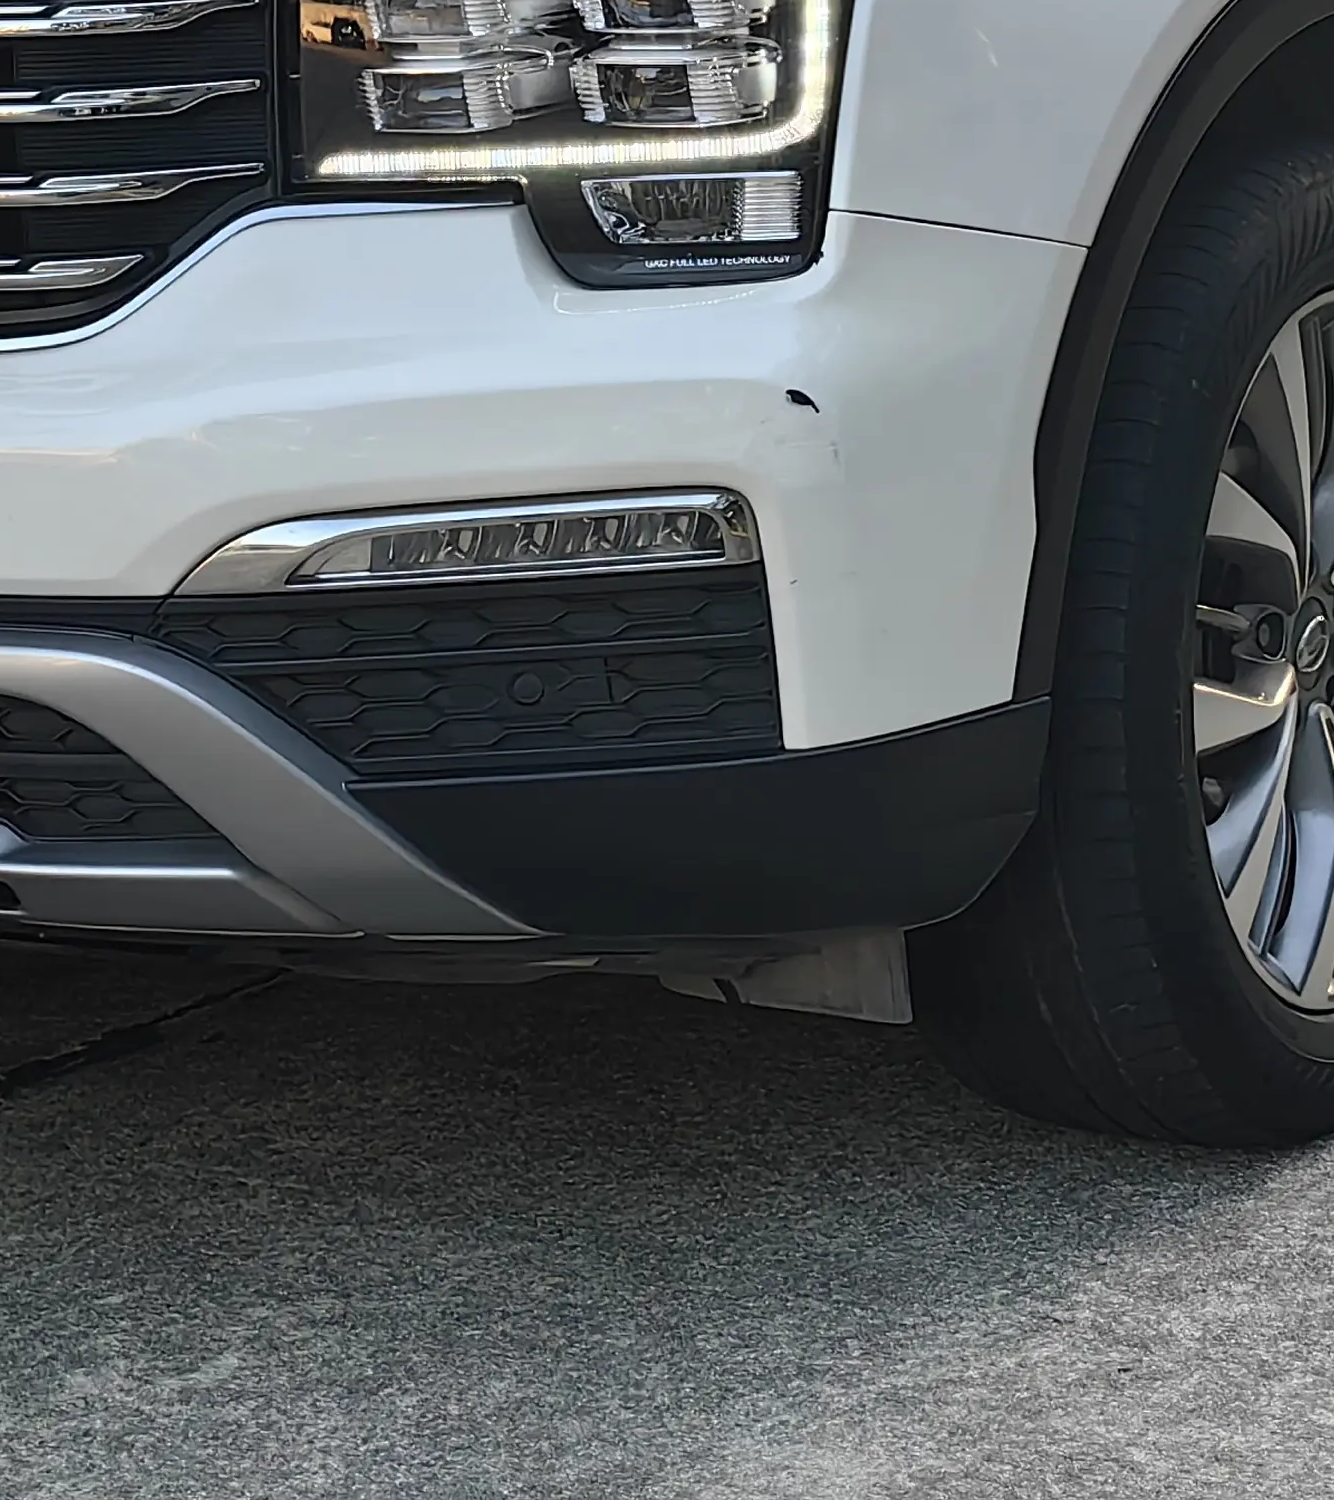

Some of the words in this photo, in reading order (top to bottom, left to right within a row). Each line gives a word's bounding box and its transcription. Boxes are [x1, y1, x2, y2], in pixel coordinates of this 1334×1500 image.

[670, 257, 695, 268] FULL
[697, 256, 718, 267] LED
[720, 254, 791, 266] TECHNOLOGY
